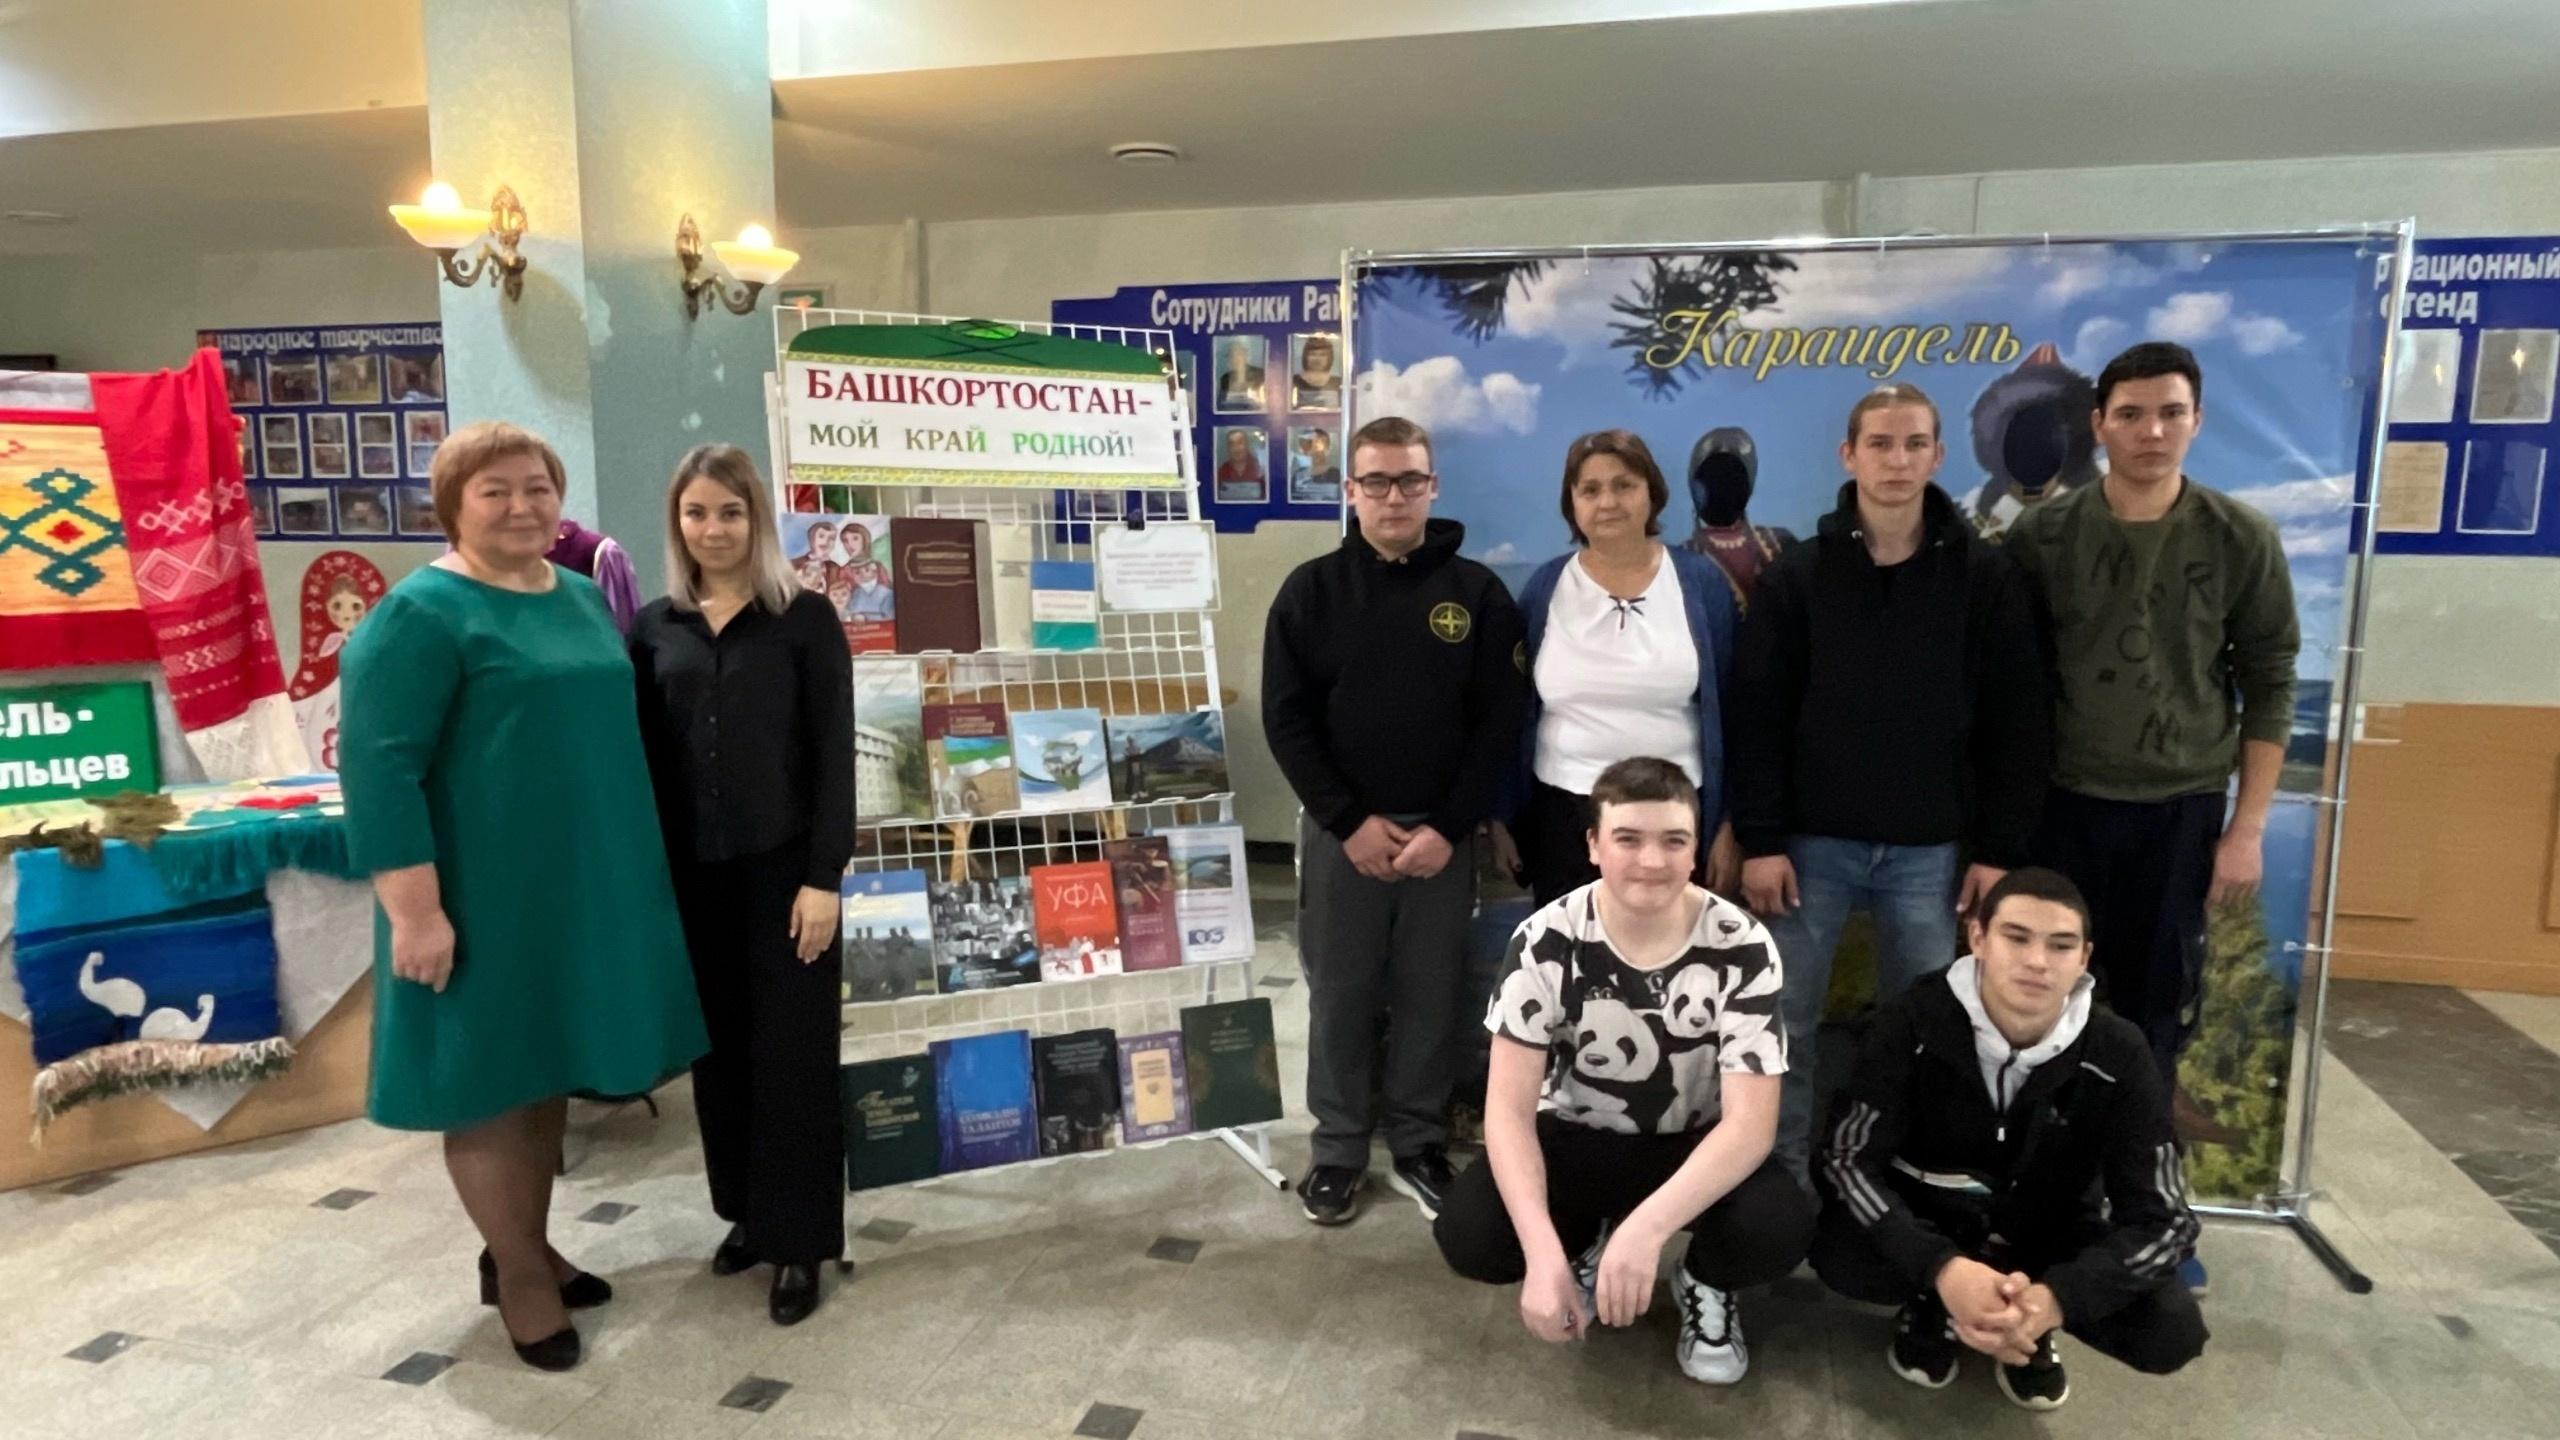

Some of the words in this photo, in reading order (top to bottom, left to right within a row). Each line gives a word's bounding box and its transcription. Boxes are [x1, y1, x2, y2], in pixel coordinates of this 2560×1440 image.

[2373, 246, 2560, 291] рационный
[1151, 289, 1290, 334] Сотрудники
[1645, 308, 2022, 382] Караидель
[806, 368, 1153, 415] БАШКОРТОСТАН-
[809, 419, 879, 449] МОЙ
[905, 425, 987, 453] КРАЙ
[1012, 429, 1134, 459] РОДНОЙ!
[1046, 882, 1108, 912] УФА
